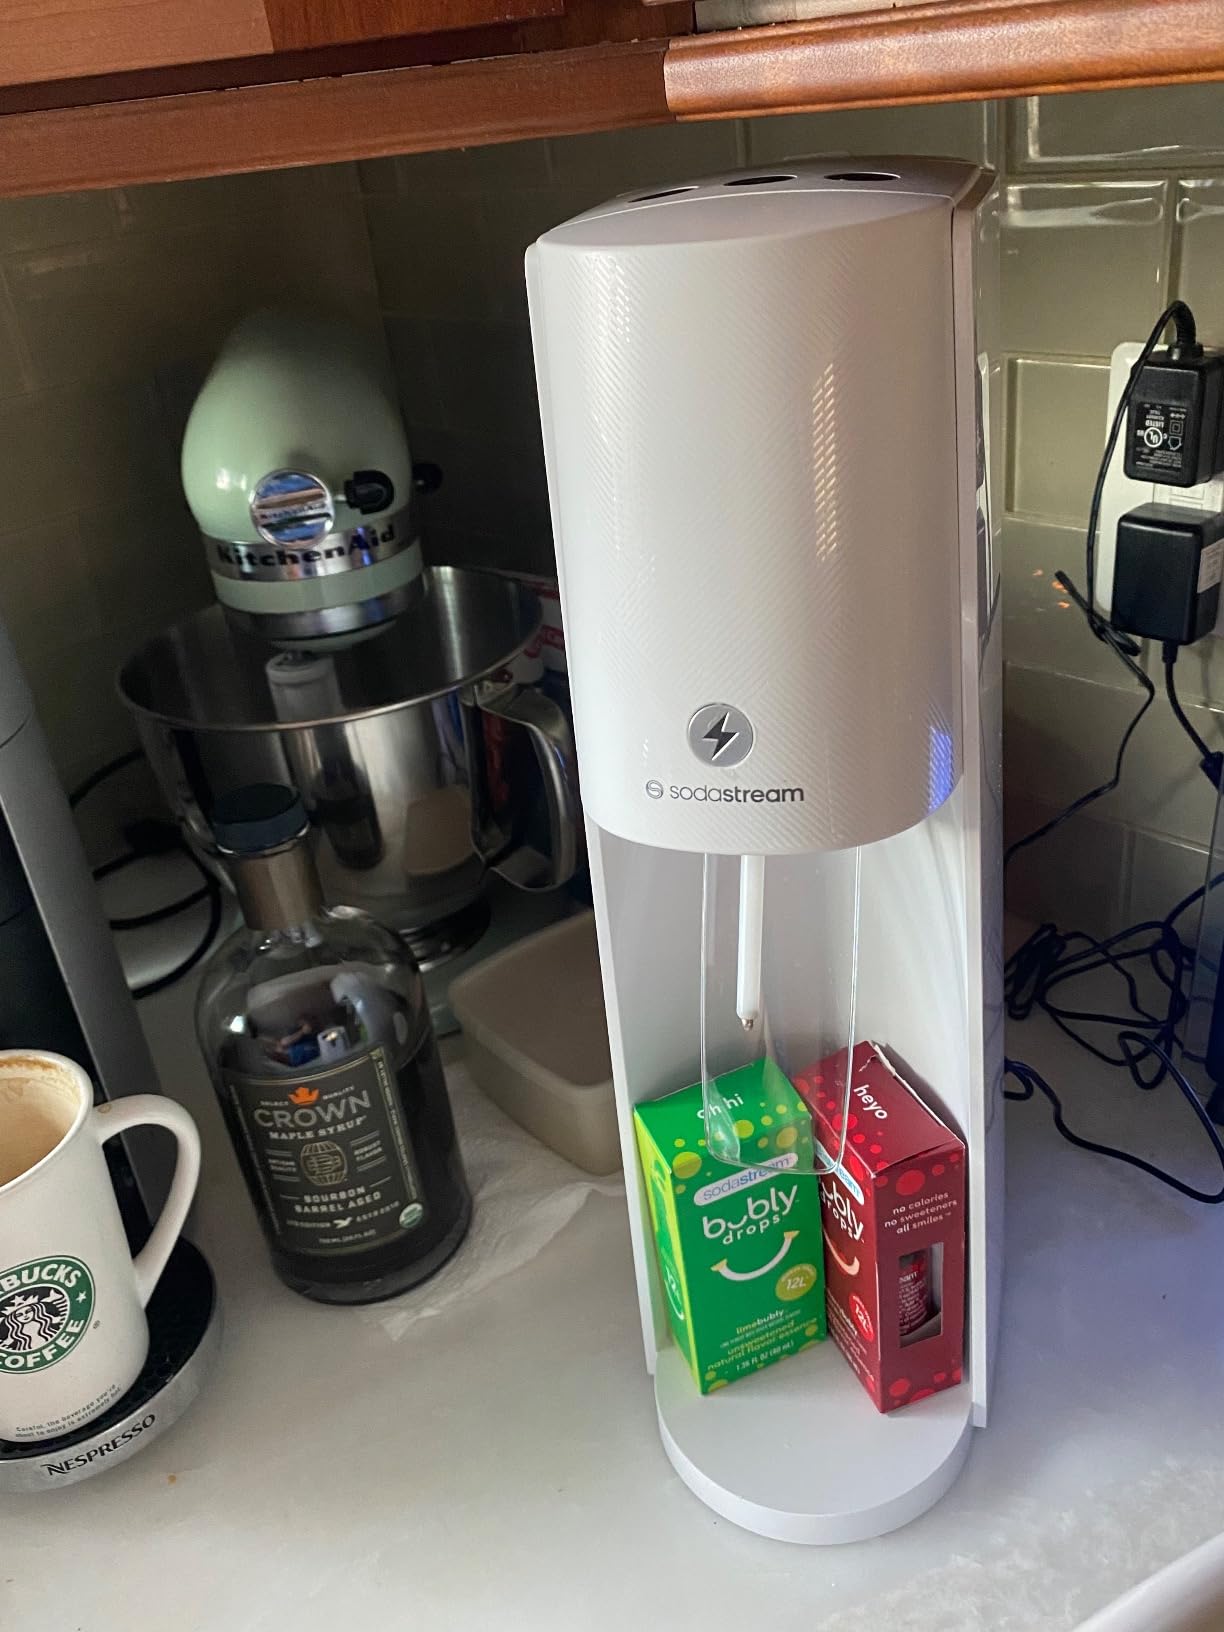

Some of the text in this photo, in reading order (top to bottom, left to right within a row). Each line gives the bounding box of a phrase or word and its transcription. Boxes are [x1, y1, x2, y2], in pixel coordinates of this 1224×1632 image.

[216, 524, 395, 567] KitchenAid
[669, 785, 805, 803] sodastream
[253, 1090, 371, 1128] CROWN
[722, 1093, 745, 1110] hi
[853, 1083, 889, 1121] heyo
[268, 1115, 365, 1141] MAPLE SYRUP
[294, 1191, 382, 1214] BARREL AGED
[303, 1186, 366, 1203] BOURBON
[892, 1192, 949, 1215] no calories
[702, 1184, 798, 1239] bubly
[821, 1180, 864, 1241] ubly
[884, 1199, 958, 1228] no sweeteners
[722, 1213, 781, 1245] drops
[896, 1214, 944, 1235] all smiles
[0, 1263, 82, 1294] BUCKS
[785, 1276, 808, 1291] 12L
[735, 1309, 784, 1335] limebubly
[707, 1348, 745, 1370] natural
[47, 1419, 60, 1427] the
[61, 1400, 95, 1422] beverage
[40, 1414, 156, 1476] NESPRESSO
